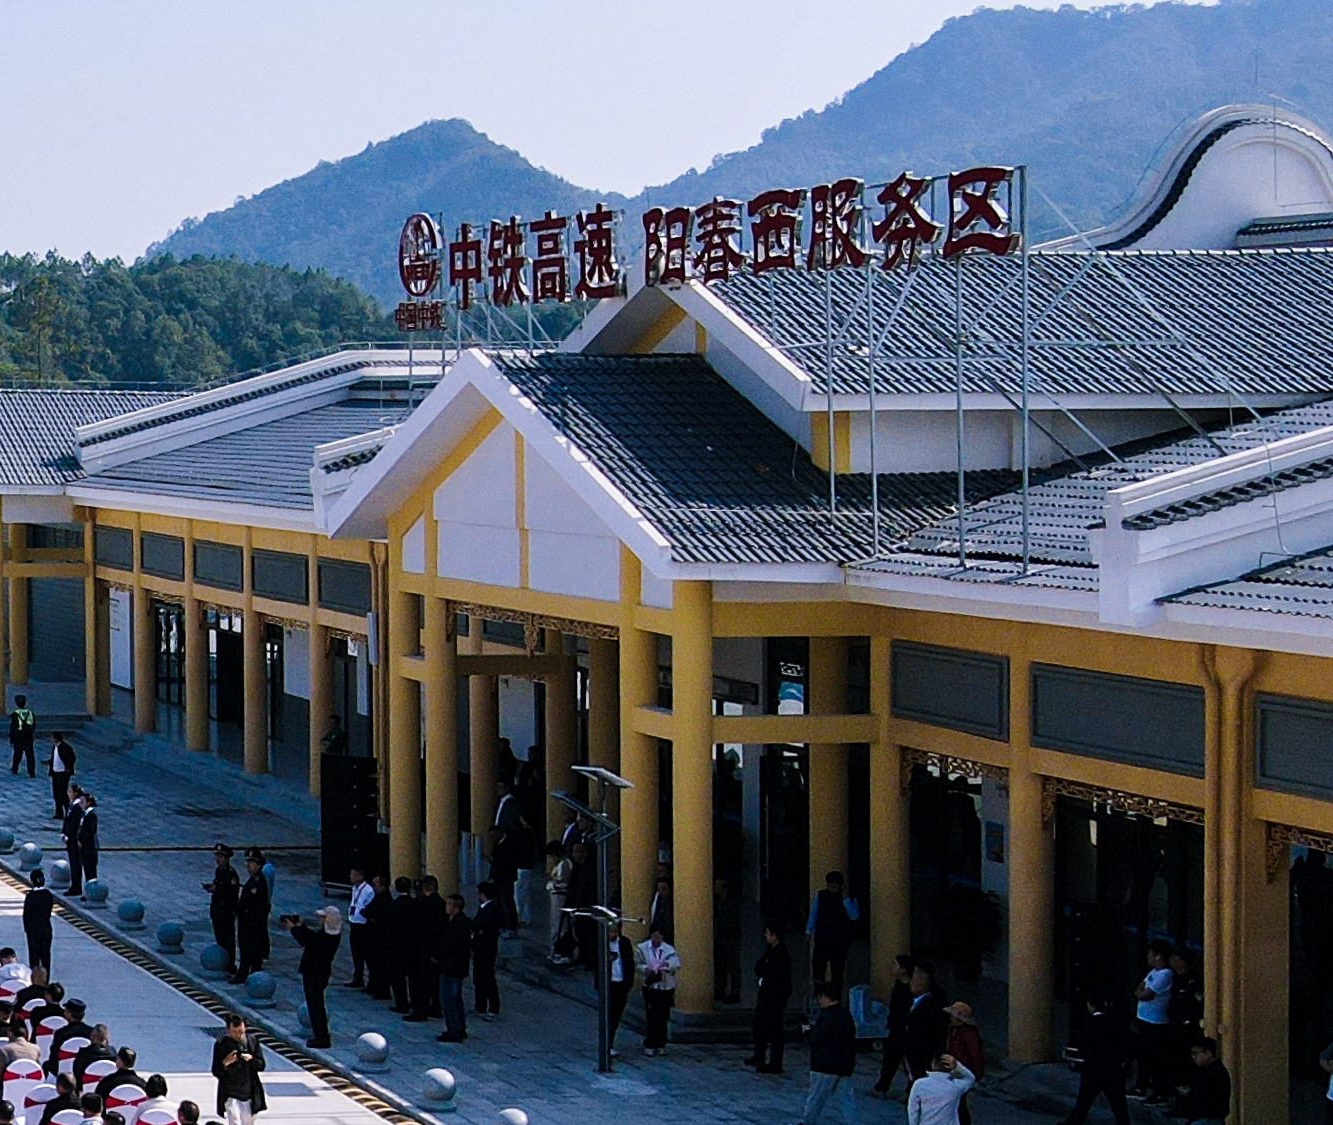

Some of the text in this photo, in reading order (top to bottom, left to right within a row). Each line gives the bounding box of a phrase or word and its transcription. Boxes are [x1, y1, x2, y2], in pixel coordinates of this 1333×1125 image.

[450, 168, 1017, 309] 中铁高速 阳春西服务区
